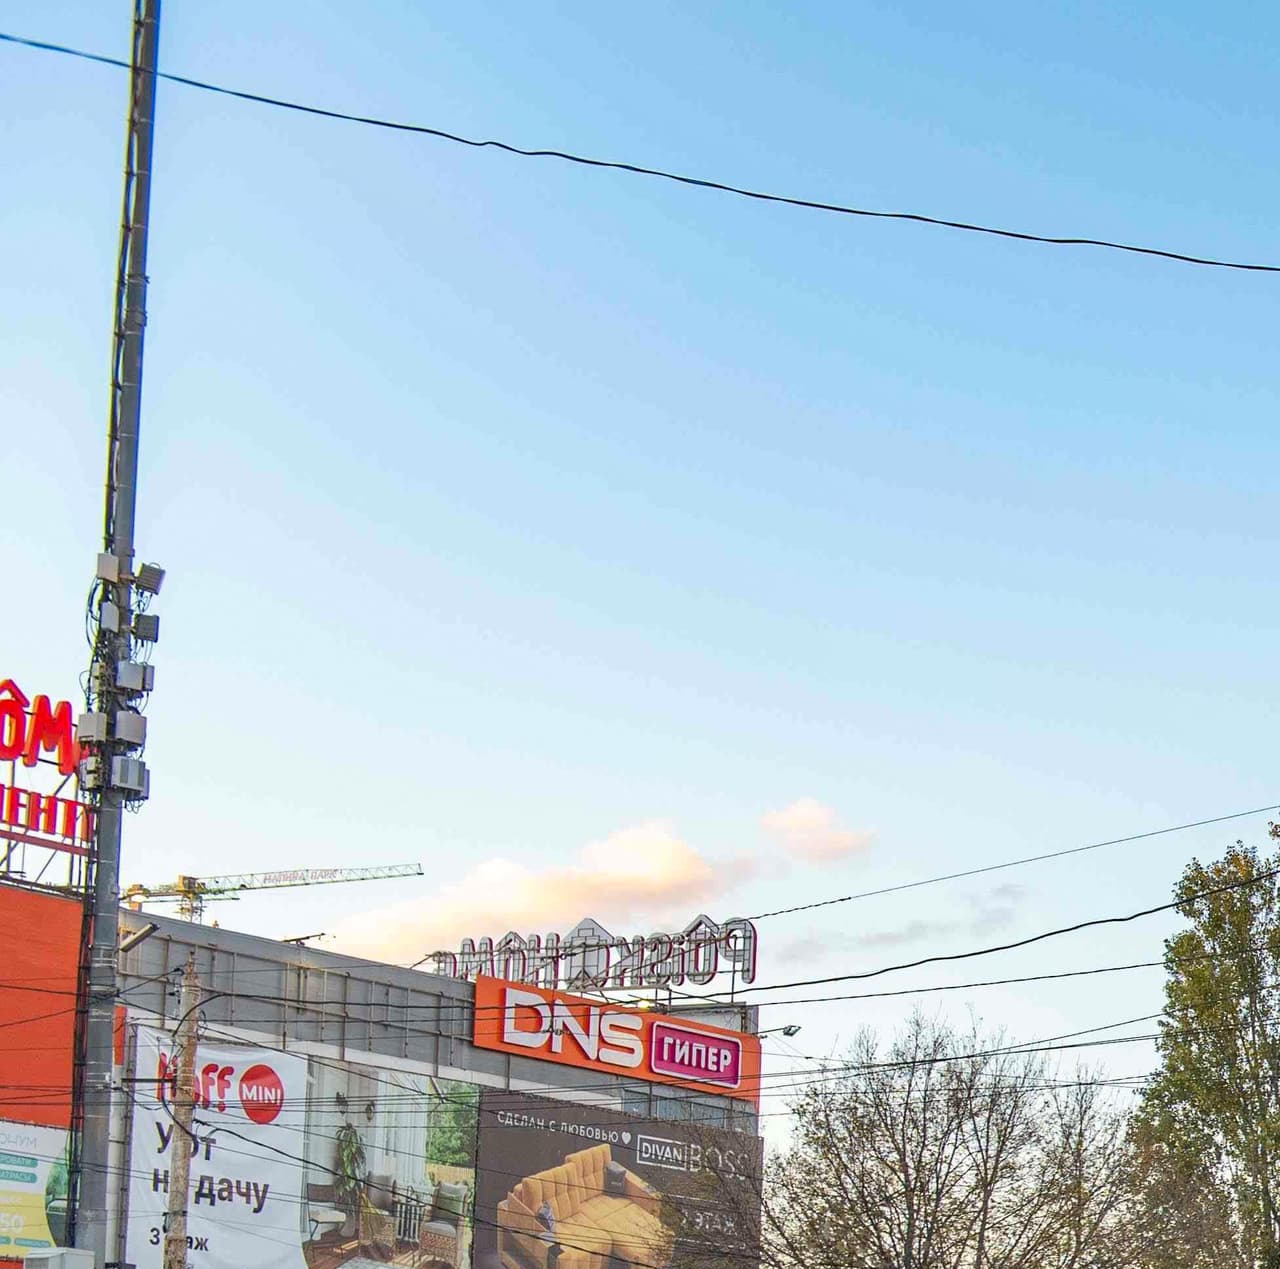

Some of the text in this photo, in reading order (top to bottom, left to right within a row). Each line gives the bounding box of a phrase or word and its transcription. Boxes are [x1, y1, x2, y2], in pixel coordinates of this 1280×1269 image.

[504, 987, 644, 1069] DNS
[663, 1036, 732, 1073] ГИПЕР
[241, 1084, 282, 1106] MINI
[155, 1121, 216, 1161] Ут
[497, 1111, 619, 1142] СДЕЛАН С ЛЮБОВЬЮ
[642, 1143, 682, 1163] DIVAN
[194, 1174, 270, 1213] дачу
[149, 1227, 160, 1246] 3
